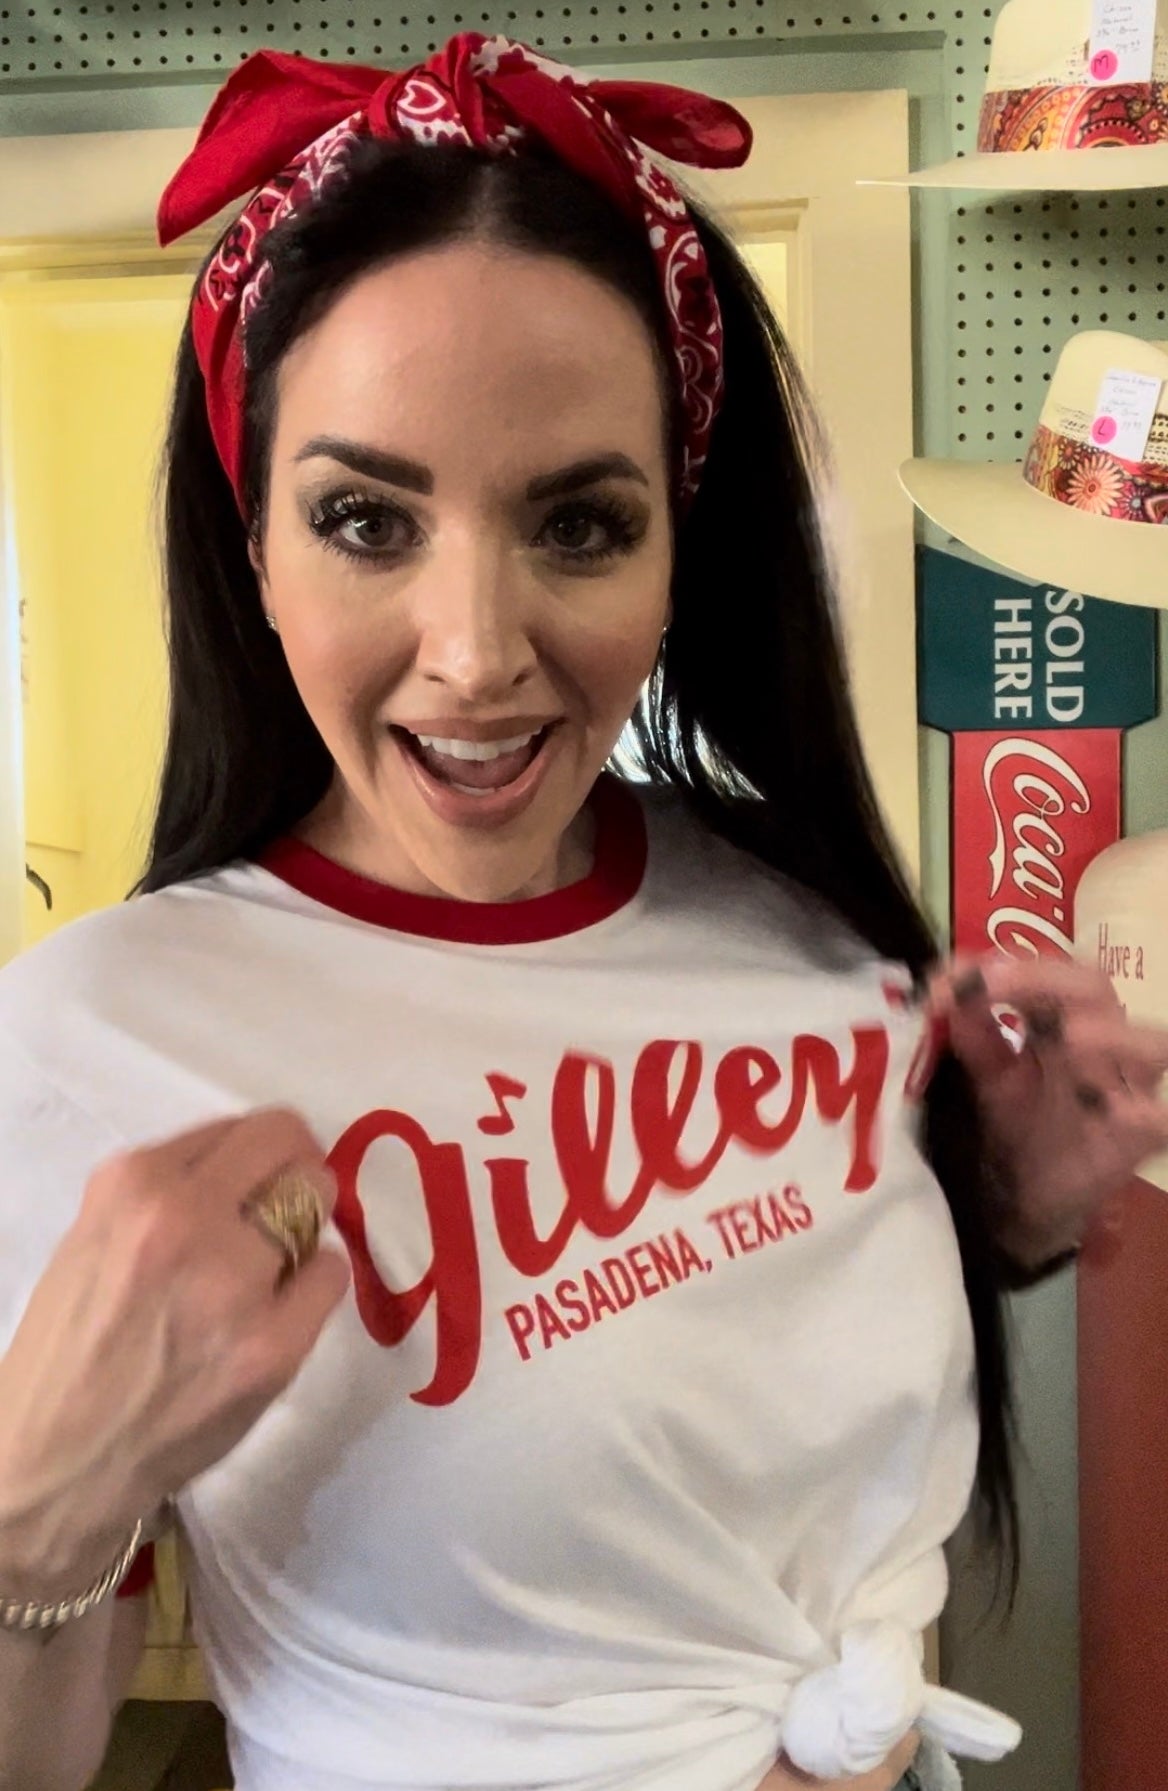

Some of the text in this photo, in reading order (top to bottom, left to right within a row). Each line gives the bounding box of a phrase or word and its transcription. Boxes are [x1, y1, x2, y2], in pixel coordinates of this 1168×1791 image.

[993, 598, 1032, 719] HERE
[1045, 590, 1085, 722] SOLD
[1098, 922, 1144, 980] Have a
[504, 1178, 814, 1362] PASADENA, TEXAS
